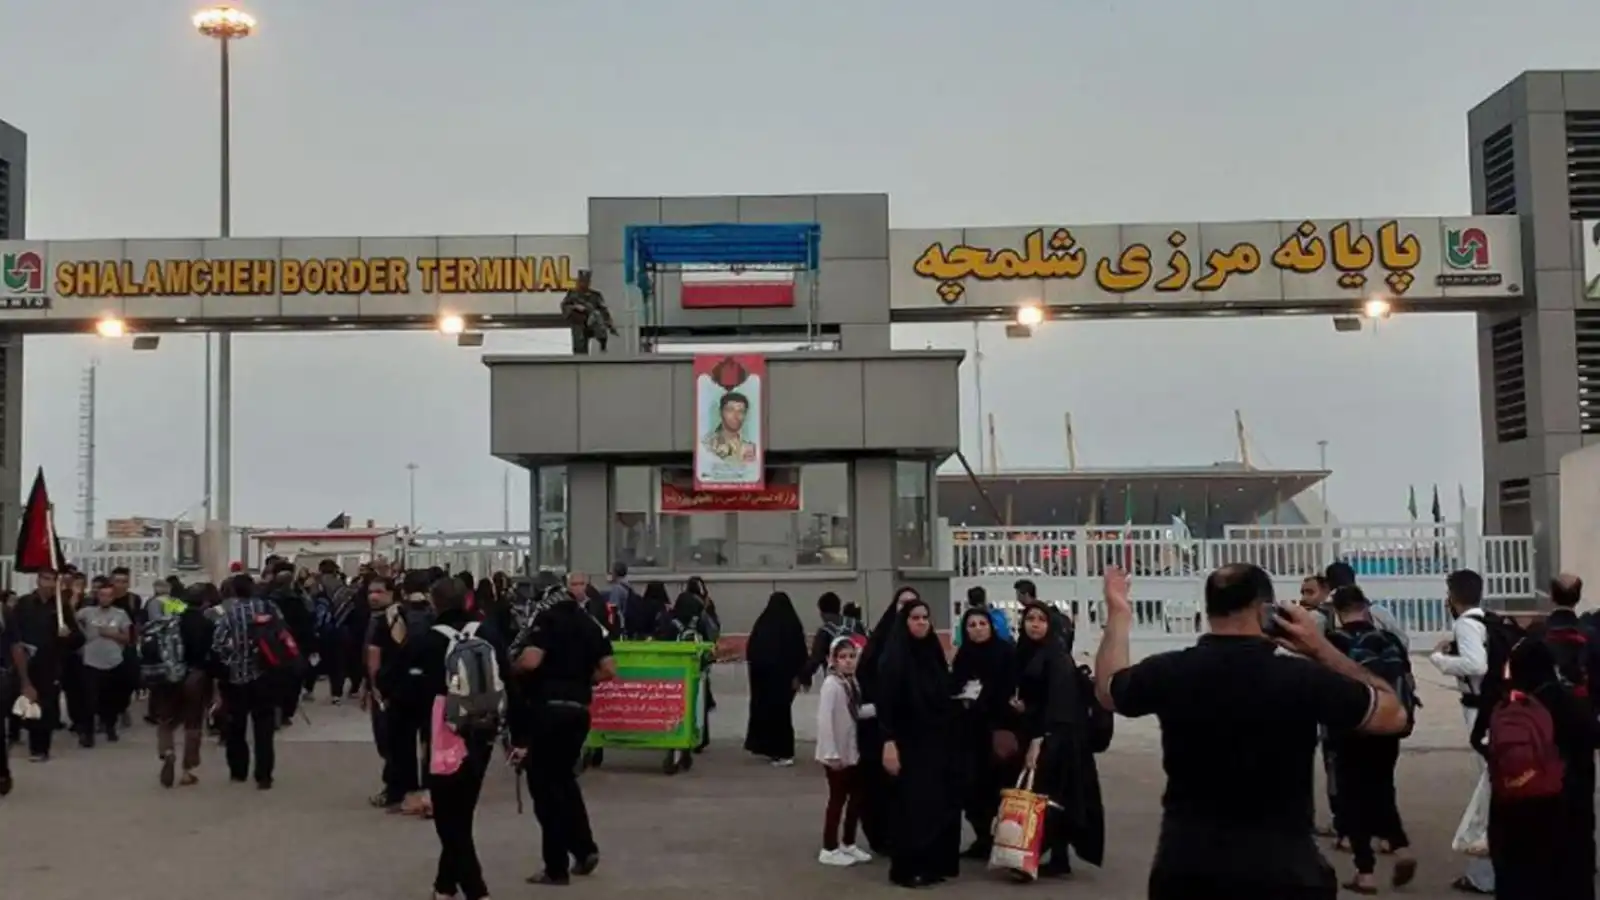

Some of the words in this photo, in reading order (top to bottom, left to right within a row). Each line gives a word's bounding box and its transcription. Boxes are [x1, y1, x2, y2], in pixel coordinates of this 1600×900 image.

[55, 259, 276, 297] SHALAMCHEH
[280, 257, 409, 295] BORDER
[416, 255, 577, 294] TERMINAL
[913, 228, 1087, 304] شلمچه
[1095, 230, 1260, 292] مرزی
[1272, 219, 1421, 296] پایانه
